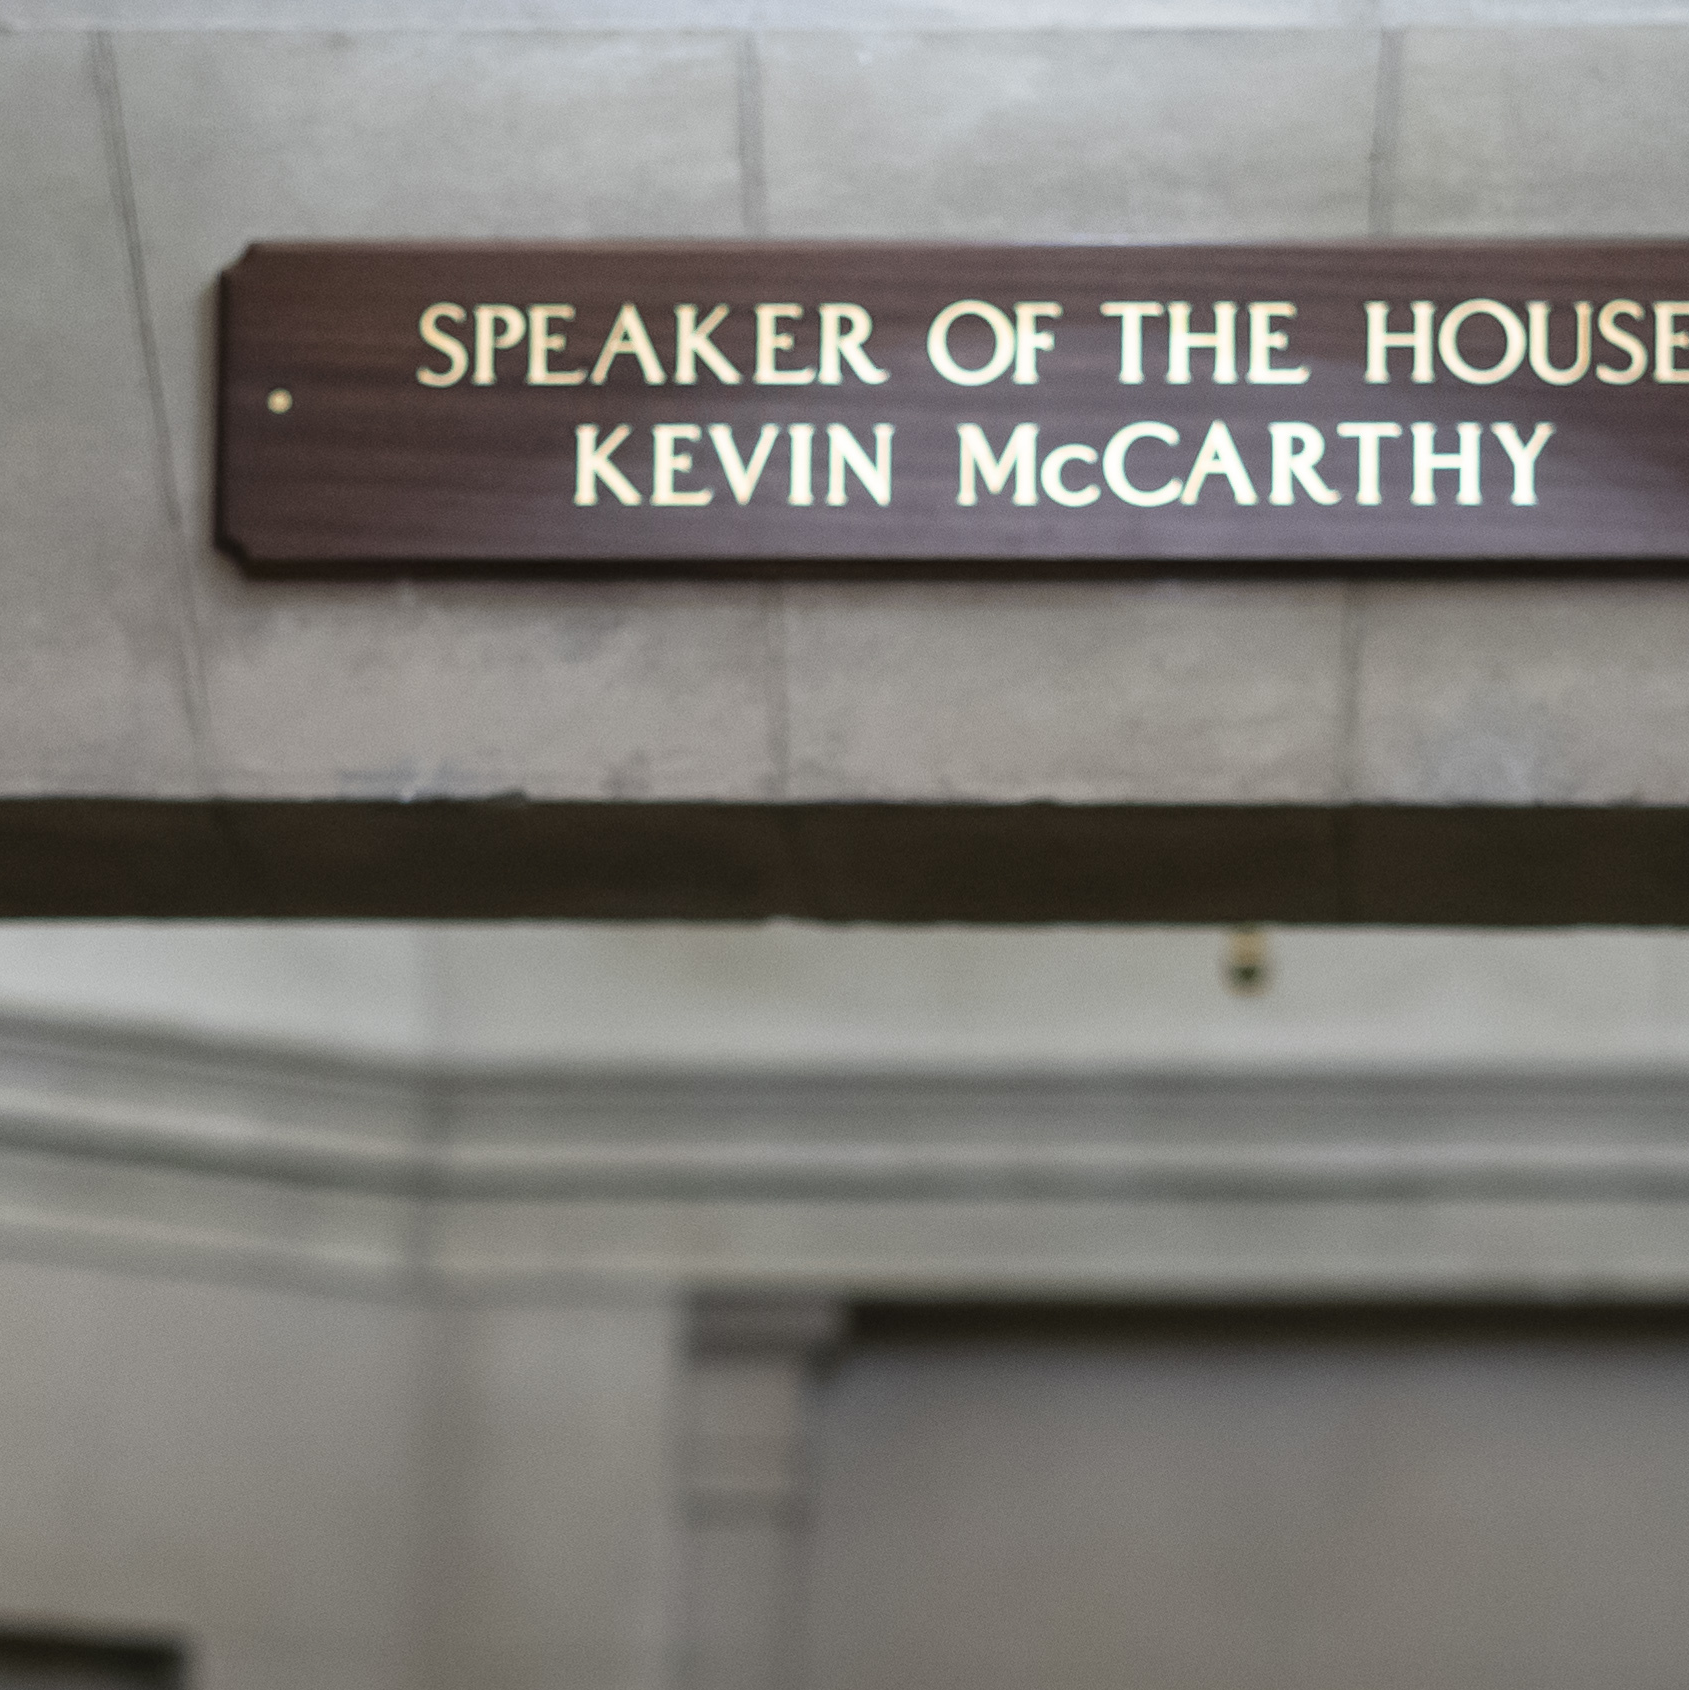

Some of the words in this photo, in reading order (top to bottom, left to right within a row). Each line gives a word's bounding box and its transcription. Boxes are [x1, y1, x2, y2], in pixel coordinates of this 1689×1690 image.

[419, 303, 892, 389] SPEAKER
[926, 301, 1063, 387] OF
[1100, 301, 1311, 386] THE
[574, 421, 896, 507] KEVIN
[955, 419, 1555, 508] McCARTHY
